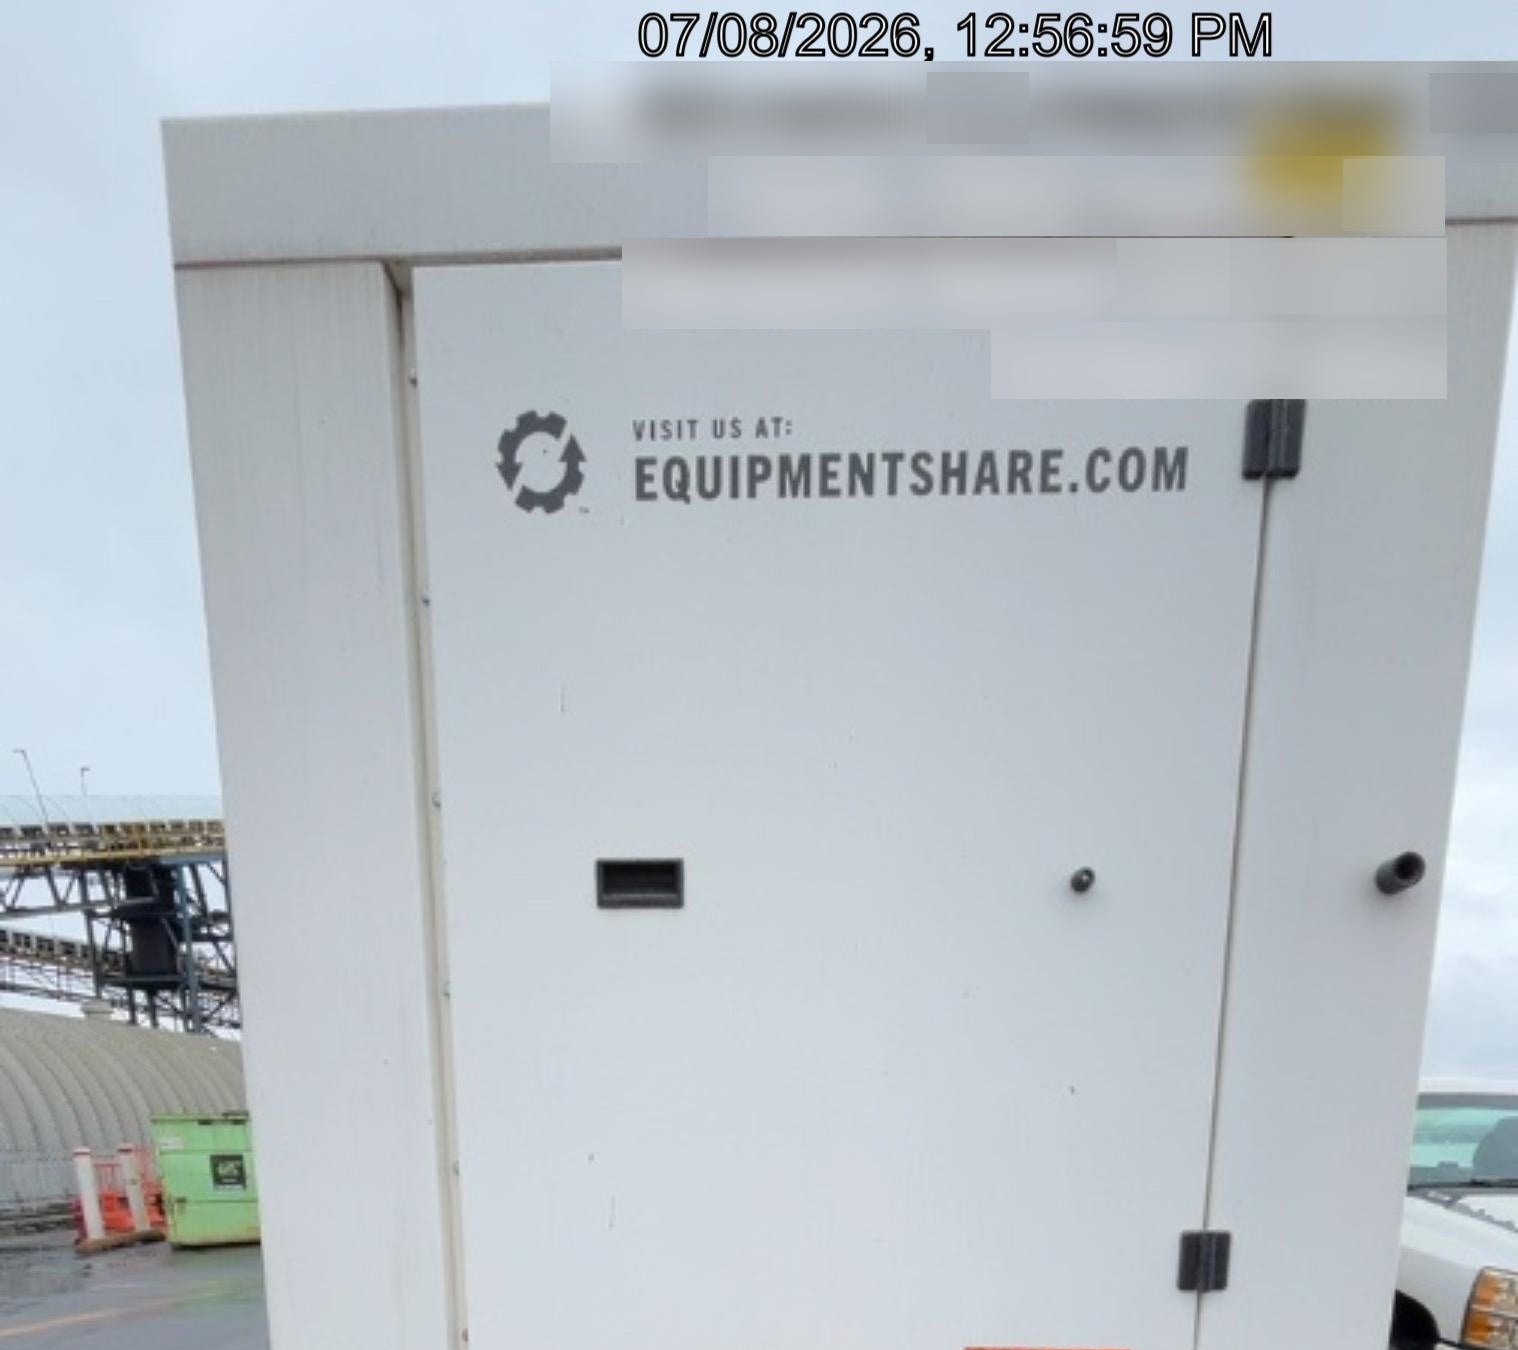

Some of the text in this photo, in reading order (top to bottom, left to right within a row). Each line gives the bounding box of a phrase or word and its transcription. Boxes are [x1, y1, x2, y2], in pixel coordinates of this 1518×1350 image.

[632, 417, 793, 441] VISIT US AT:
[635, 446, 1190, 505] EQUIPMENTSHARE.COM
